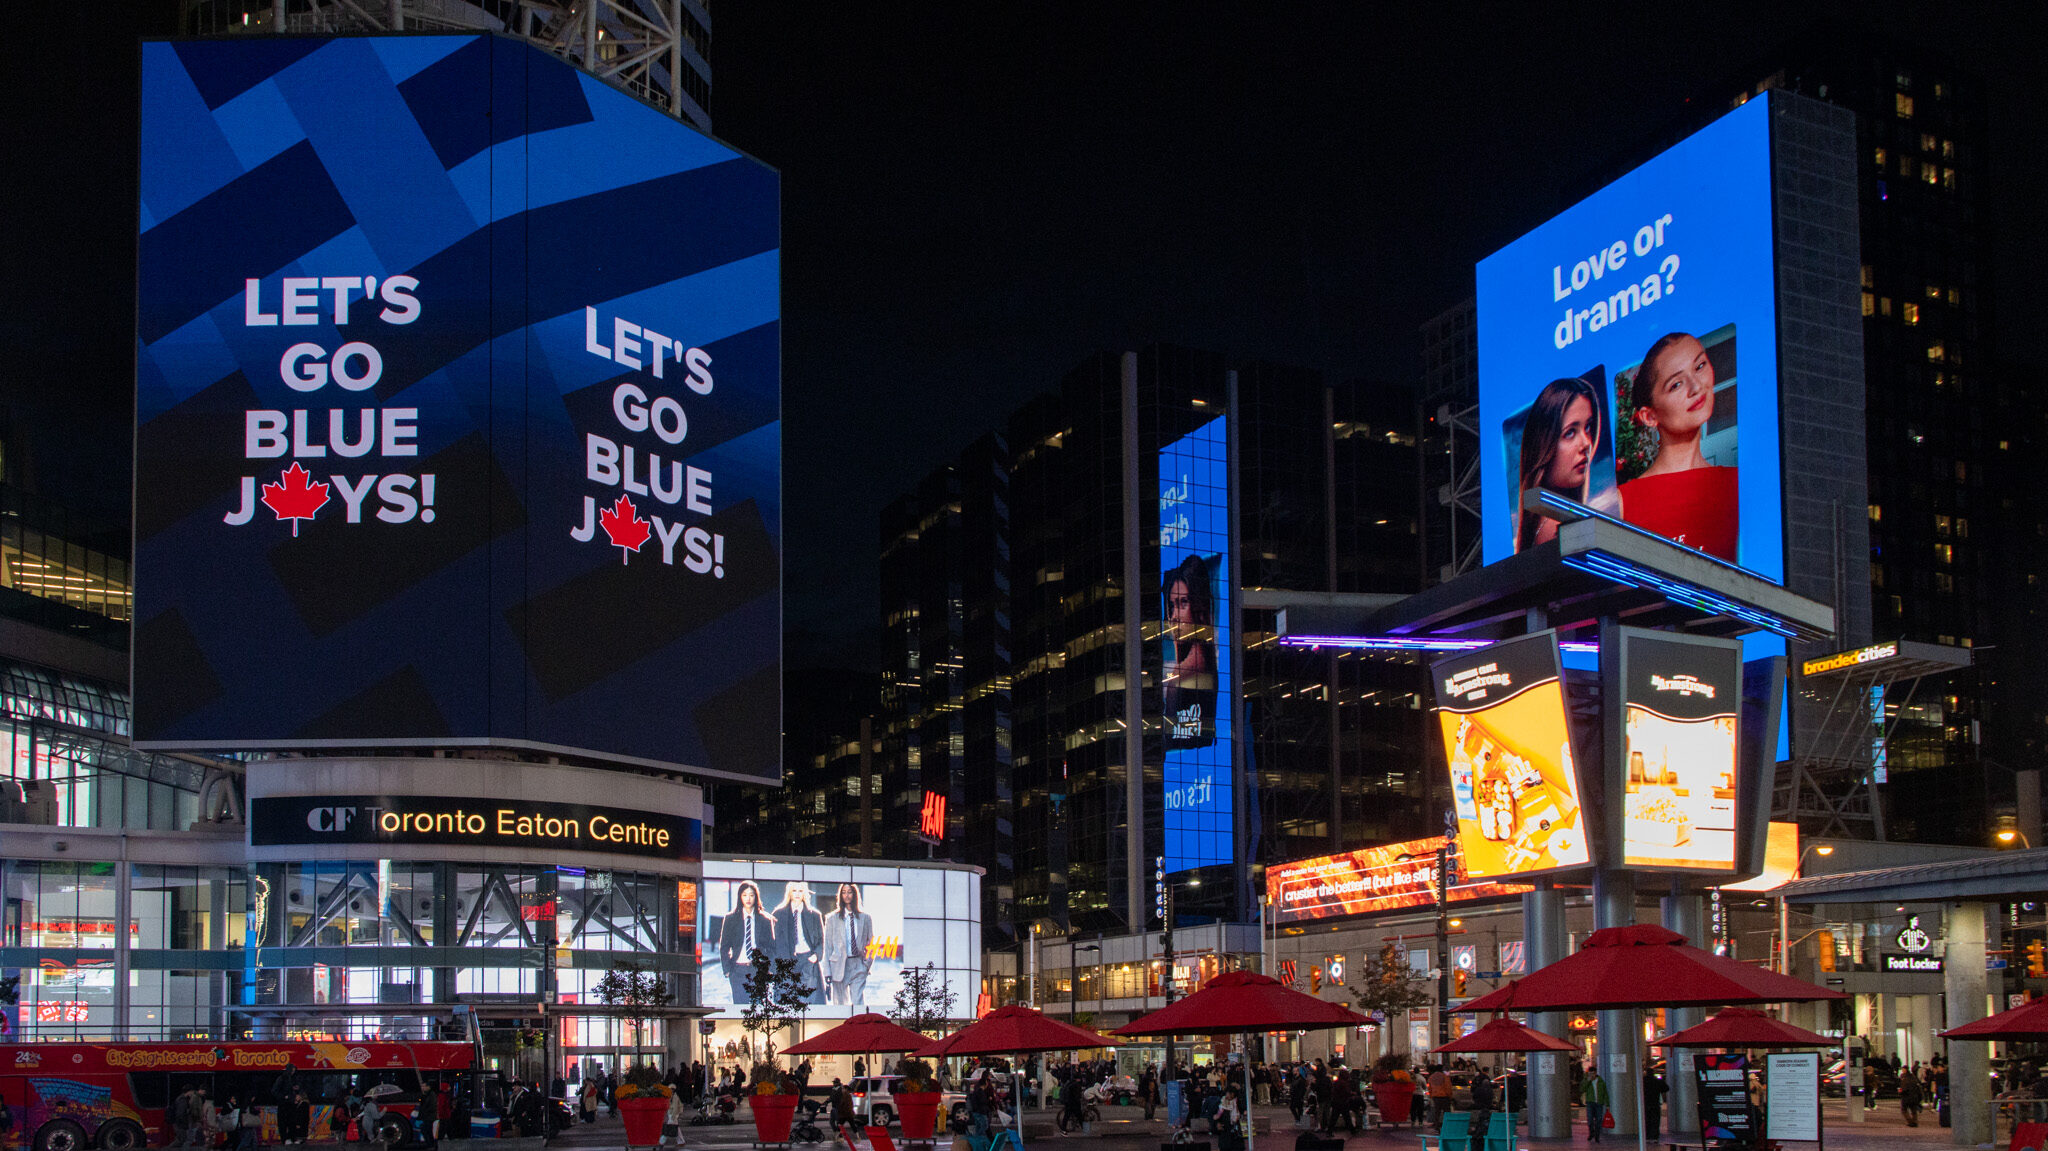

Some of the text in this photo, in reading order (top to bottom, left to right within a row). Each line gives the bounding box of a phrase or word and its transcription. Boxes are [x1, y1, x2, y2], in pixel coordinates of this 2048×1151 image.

[1553, 213, 1673, 302] Love or
[245, 275, 422, 326] LET'S
[1554, 254, 1681, 350] drama?
[280, 341, 384, 392] GO
[585, 305, 714, 396] LET'S
[245, 408, 419, 459] BLUE
[612, 383, 688, 445] GO
[586, 432, 713, 516] BLUE
[1803, 645, 1896, 676] brandedcities
[307, 806, 670, 848] CF Toronto Eaton Centre
[921, 790, 946, 840] H&M
[1319, 883, 1335, 897] the
[865, 935, 899, 960] H&M
[1888, 956, 1941, 970] Foot Locker
[107, 1049, 290, 1067] CitySightseeing Toronto
